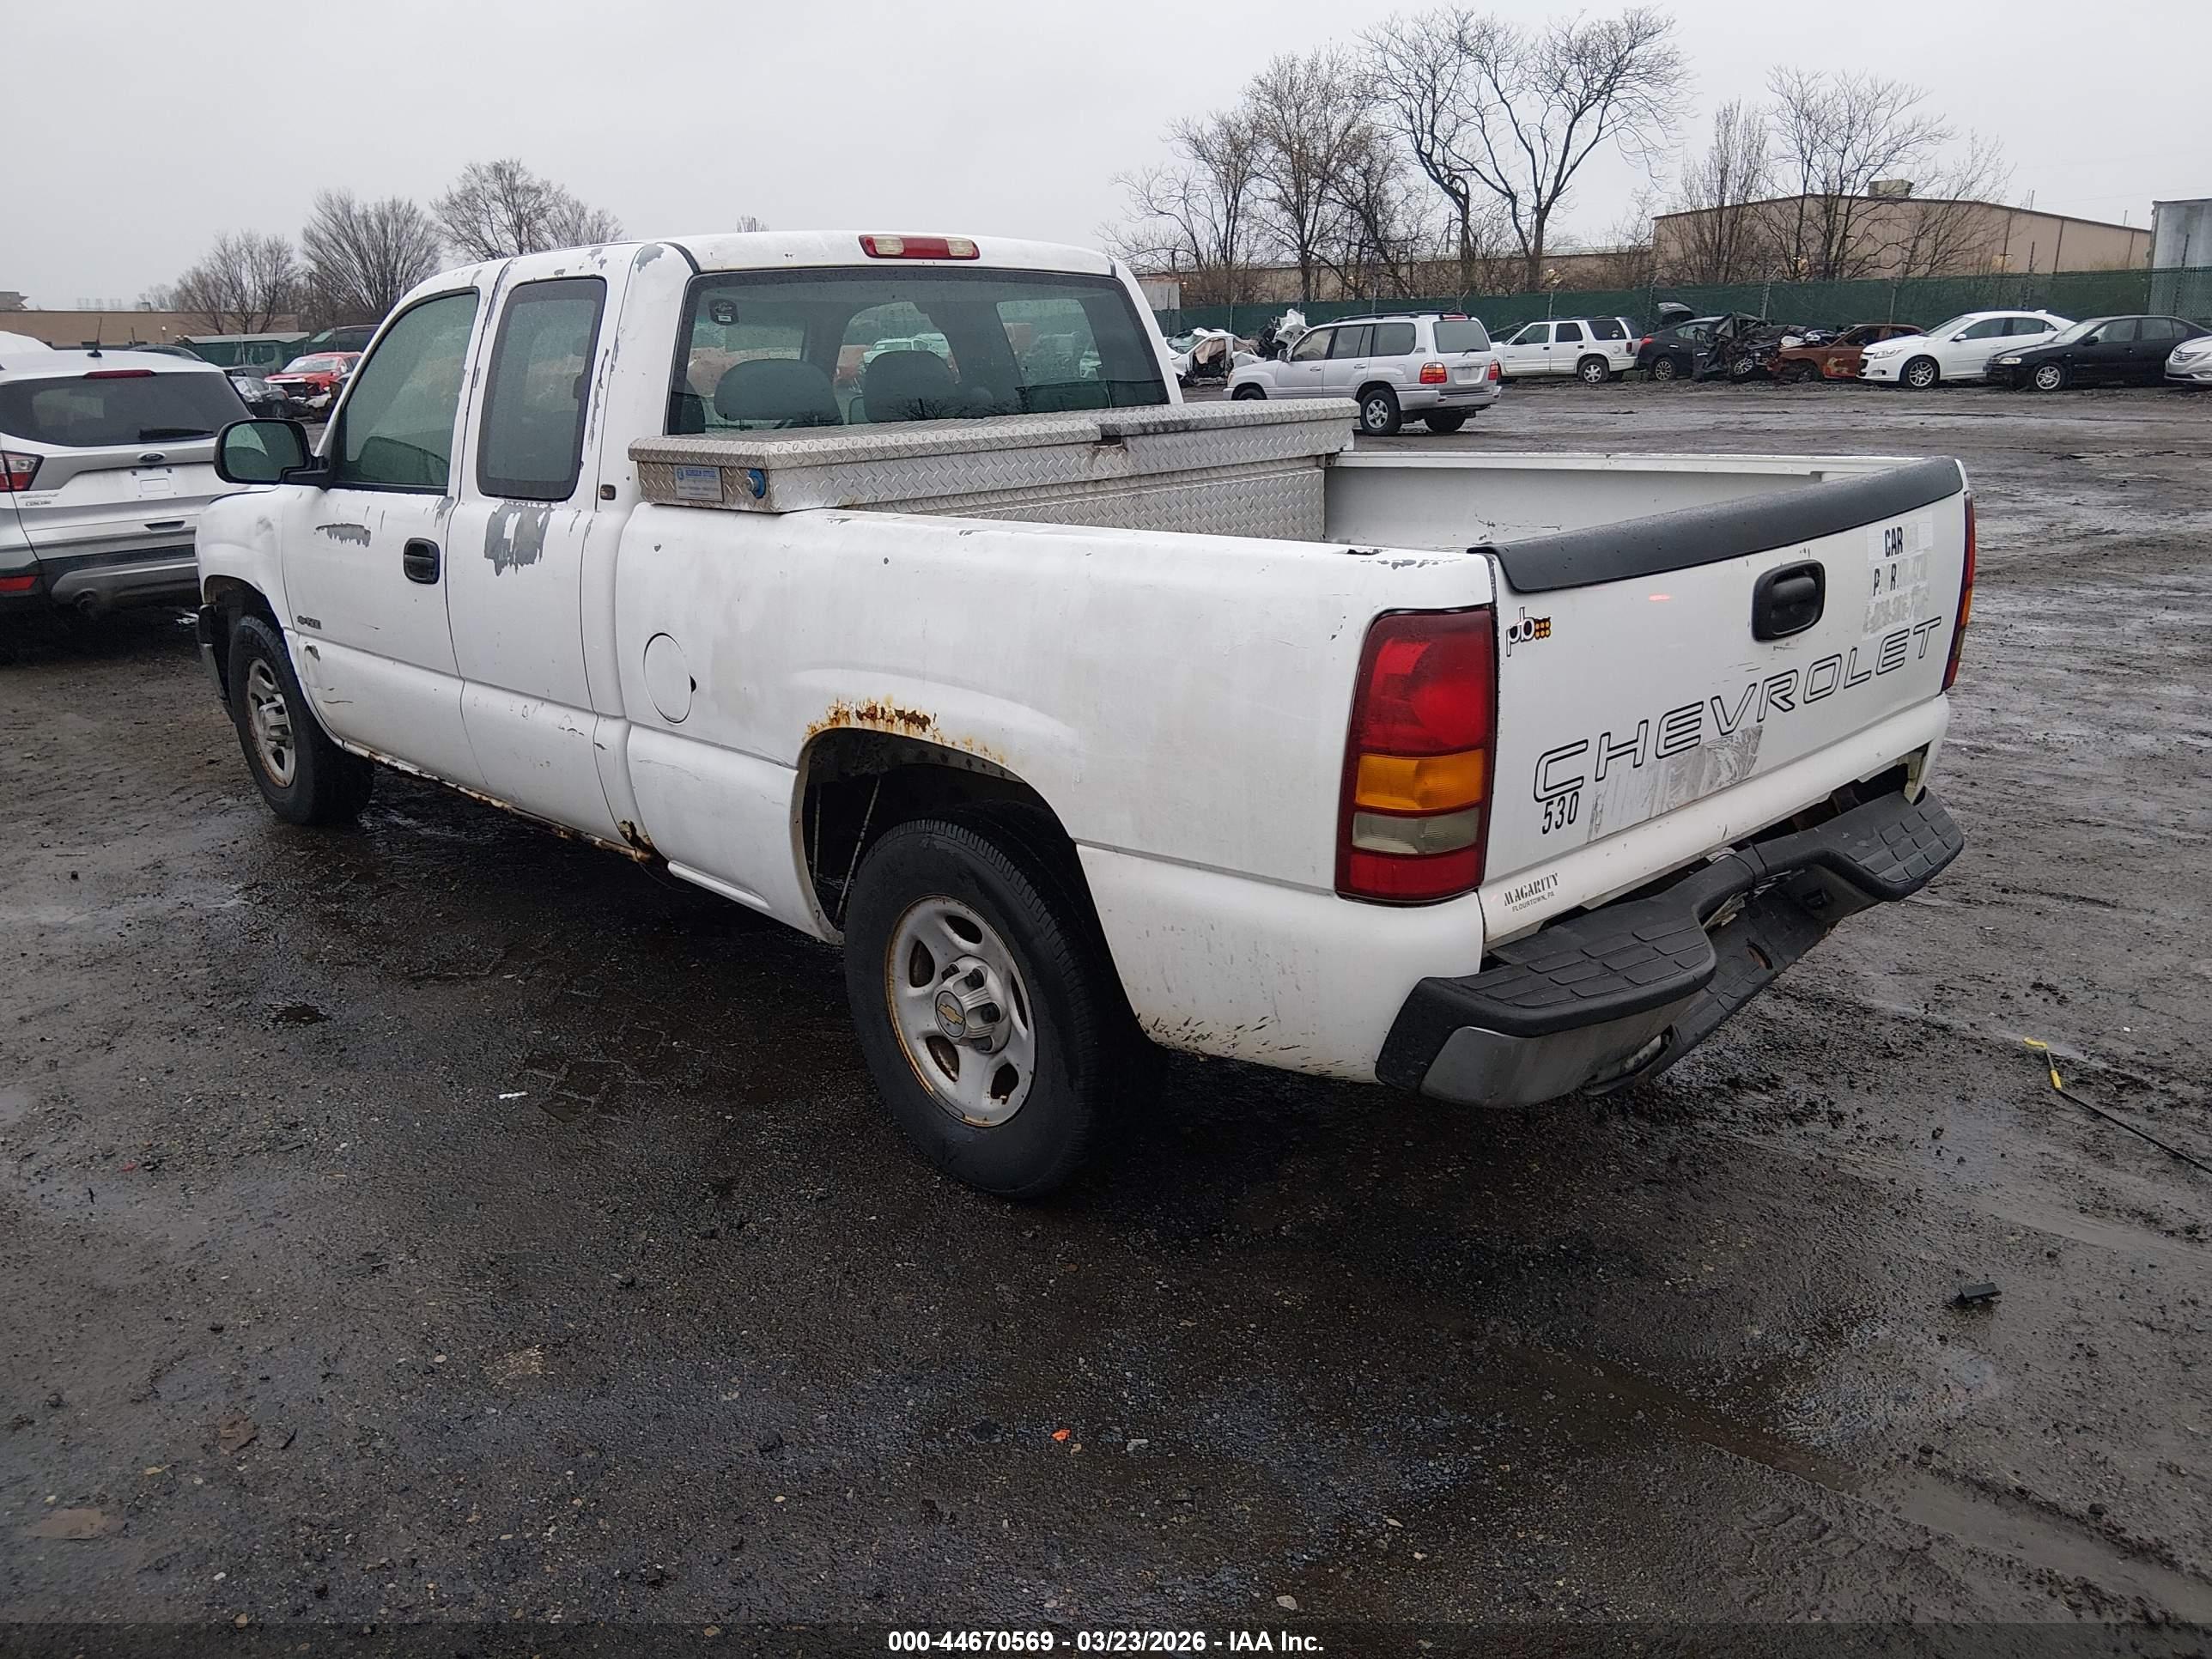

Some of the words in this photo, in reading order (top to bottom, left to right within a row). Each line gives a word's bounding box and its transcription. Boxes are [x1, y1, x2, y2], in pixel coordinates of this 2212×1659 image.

[1884, 526, 1904, 557] CAR
[1533, 616, 1942, 803] CHEVROLET
[1541, 791, 1579, 835] 530
[1504, 872, 1559, 907] MAGARITY
